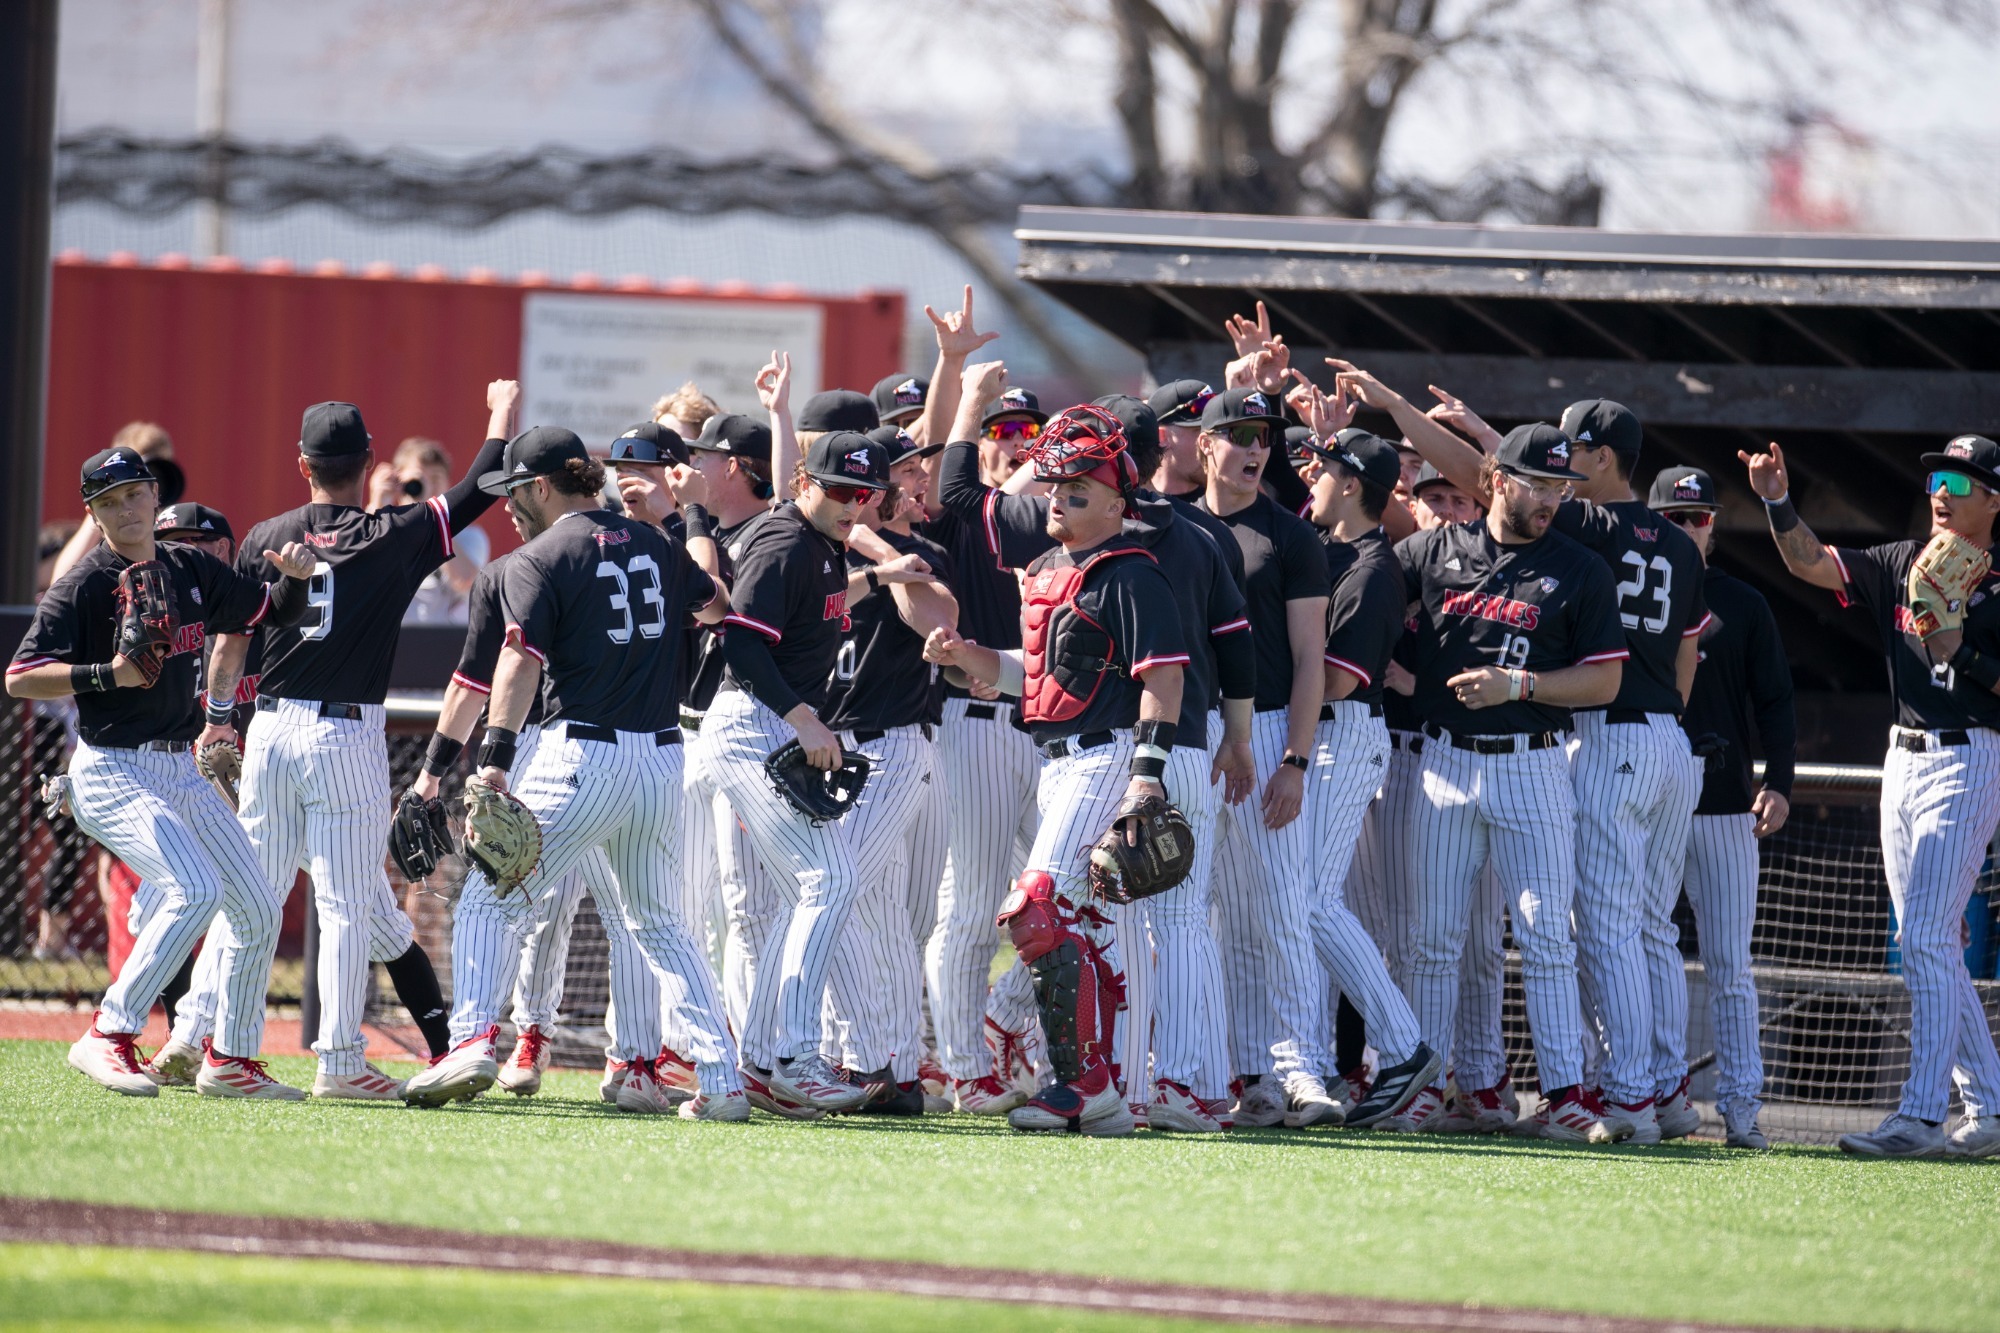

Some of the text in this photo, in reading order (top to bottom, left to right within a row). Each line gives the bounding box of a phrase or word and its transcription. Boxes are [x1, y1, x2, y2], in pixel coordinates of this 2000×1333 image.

[1244, 404, 1268, 416] NIU
[843, 461, 870, 476] NIU
[1546, 456, 1568, 468] NIU
[1674, 489, 1702, 500] NIU
[304, 530, 339, 550] NIU
[591, 527, 632, 548] NIU
[595, 553, 667, 645] 33
[1615, 549, 1673, 635] 23
[1441, 588, 1541, 631] HUSKIES
[1495, 632, 1531, 670] 19
[1930, 660, 1956, 692] 21
